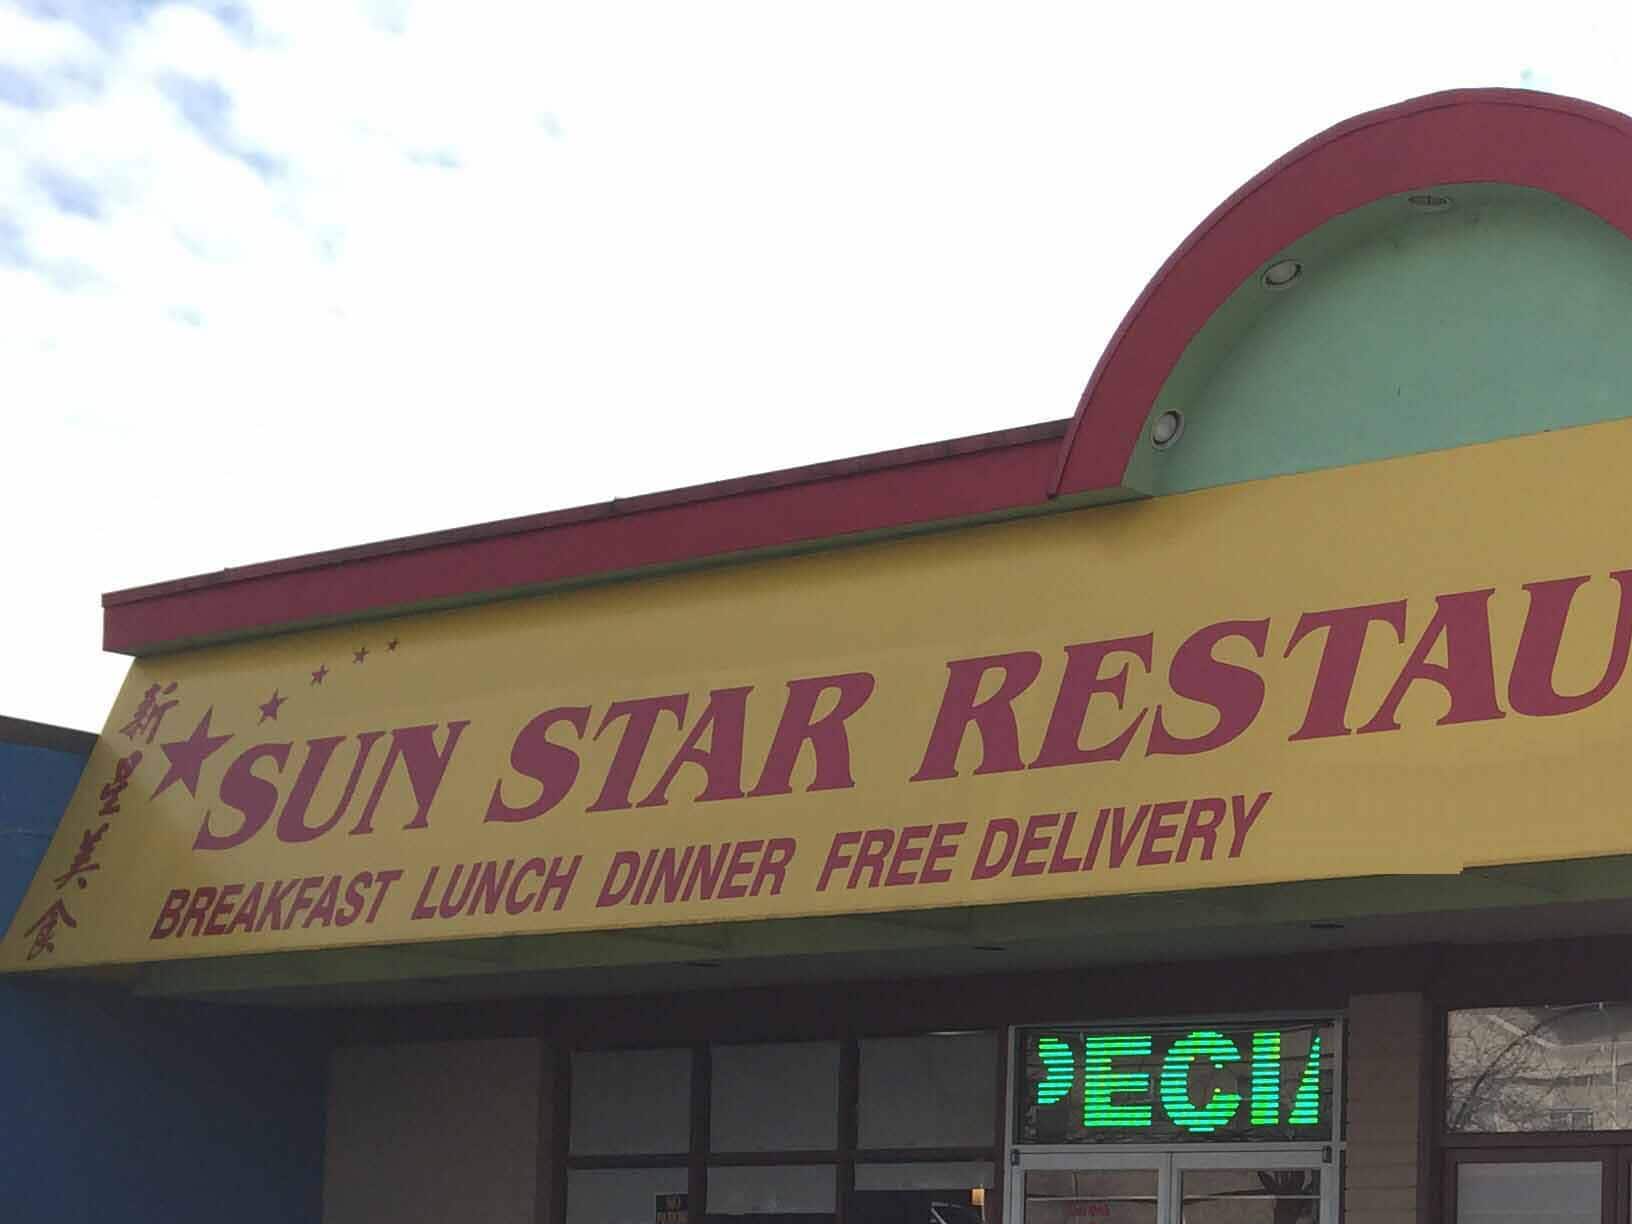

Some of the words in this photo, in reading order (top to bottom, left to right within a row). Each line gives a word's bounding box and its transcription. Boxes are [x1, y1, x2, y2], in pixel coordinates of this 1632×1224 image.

[193, 720, 470, 851] SUN
[485, 672, 875, 823] STAR
[150, 869, 402, 940] BREAKFAST
[412, 855, 583, 920] LUNCH
[596, 837, 796, 909] DINNER
[816, 821, 967, 892] FREE
[971, 791, 1272, 881] DELIVERY
